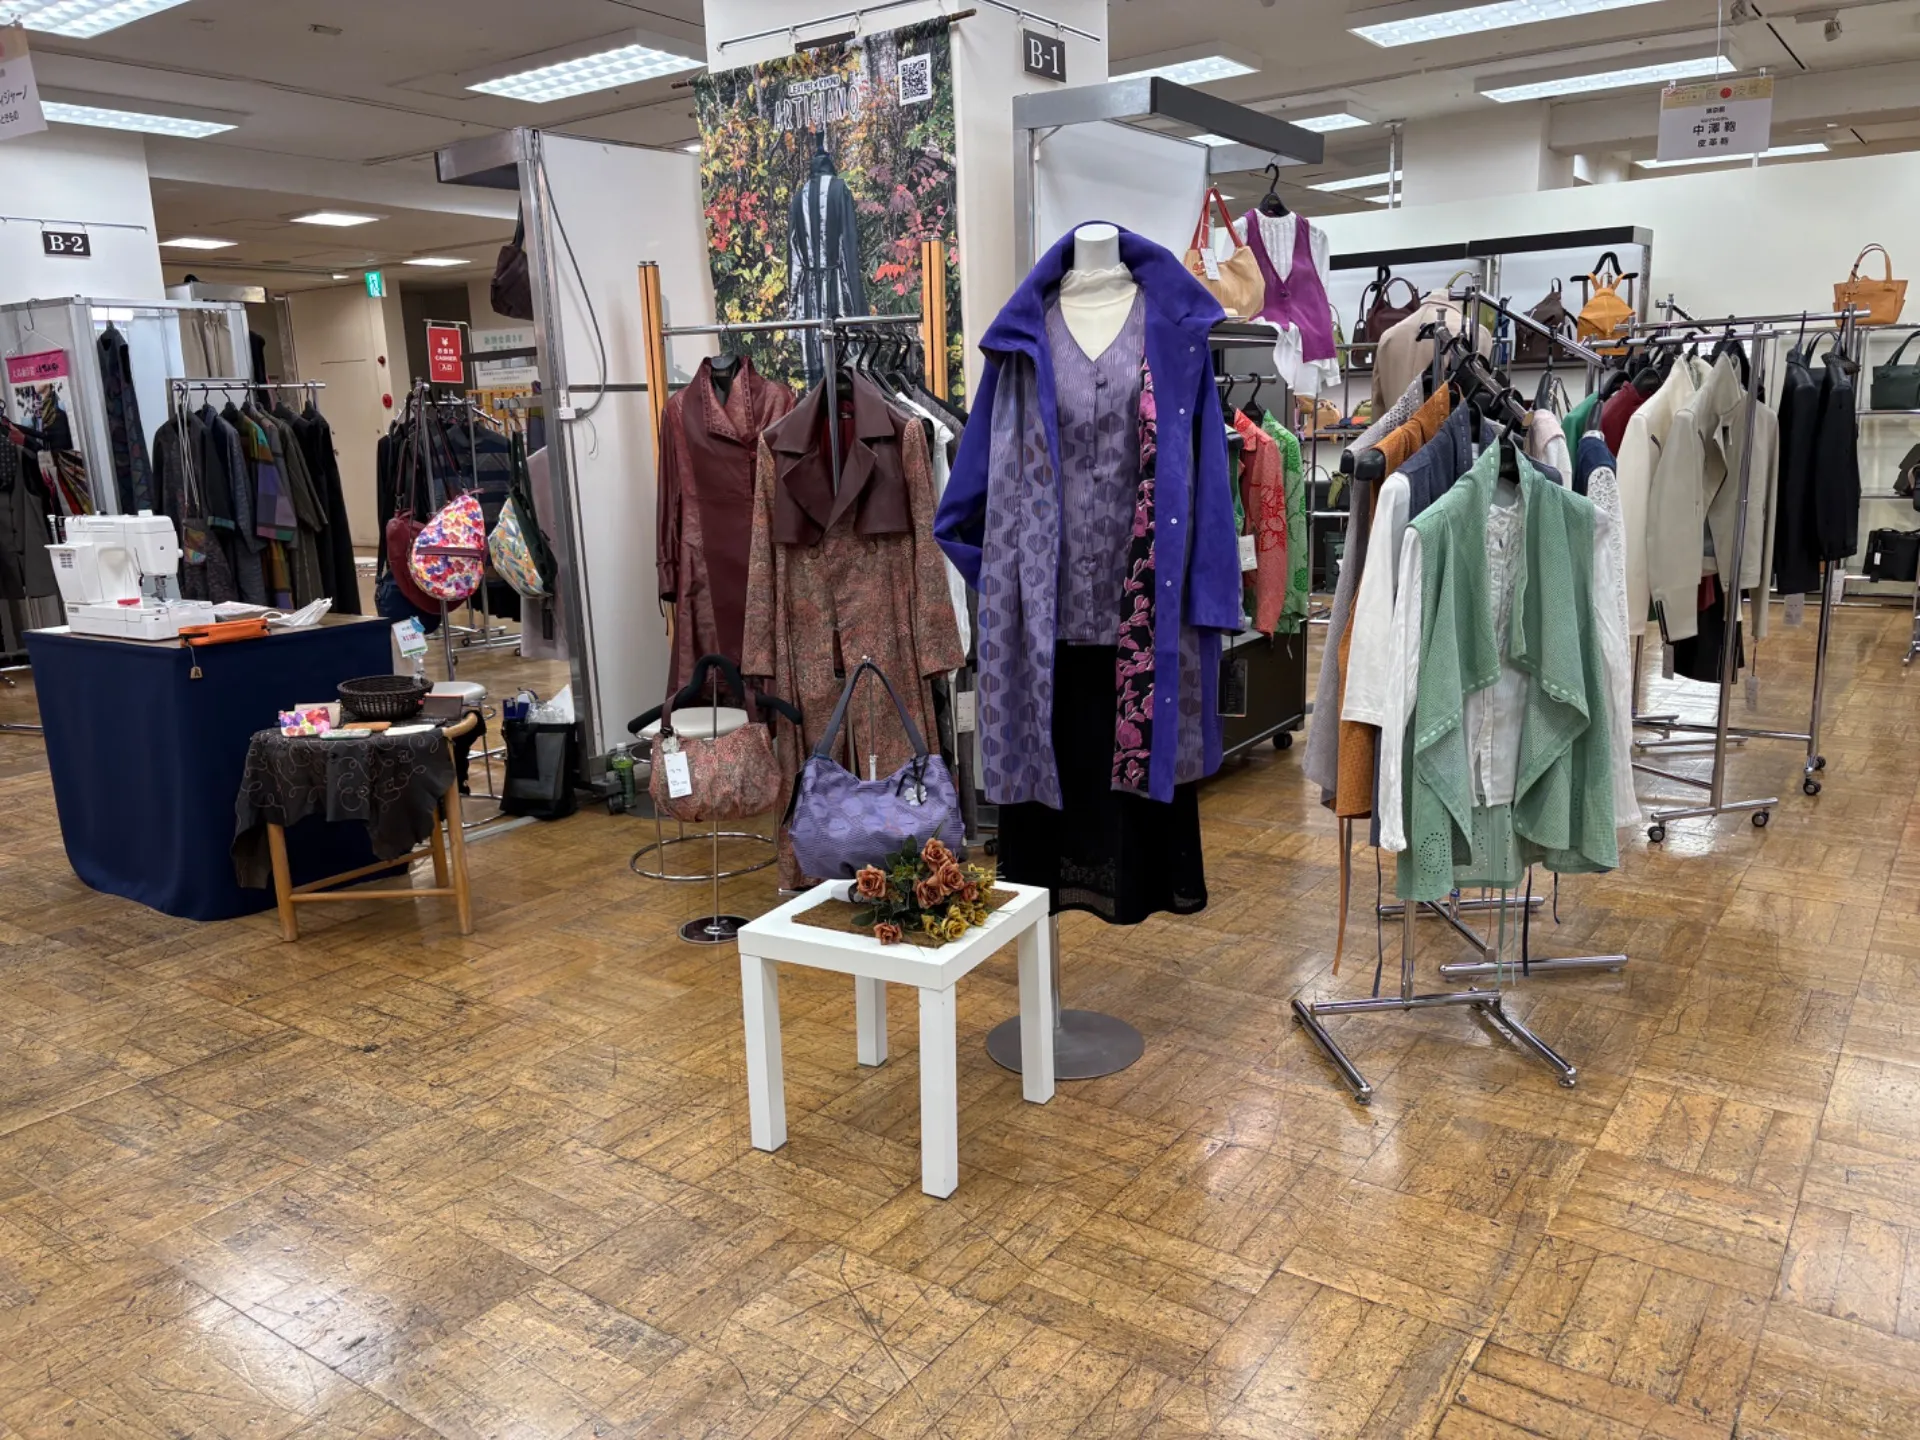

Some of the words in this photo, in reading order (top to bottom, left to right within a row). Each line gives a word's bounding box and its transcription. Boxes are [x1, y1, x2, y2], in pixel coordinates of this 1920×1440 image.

[1029, 37, 1060, 75] B-1
[774, 85, 859, 130] ARTIGIANO
[1693, 121, 1736, 136] 中澤鞄
[48, 234, 84, 252] B-2
